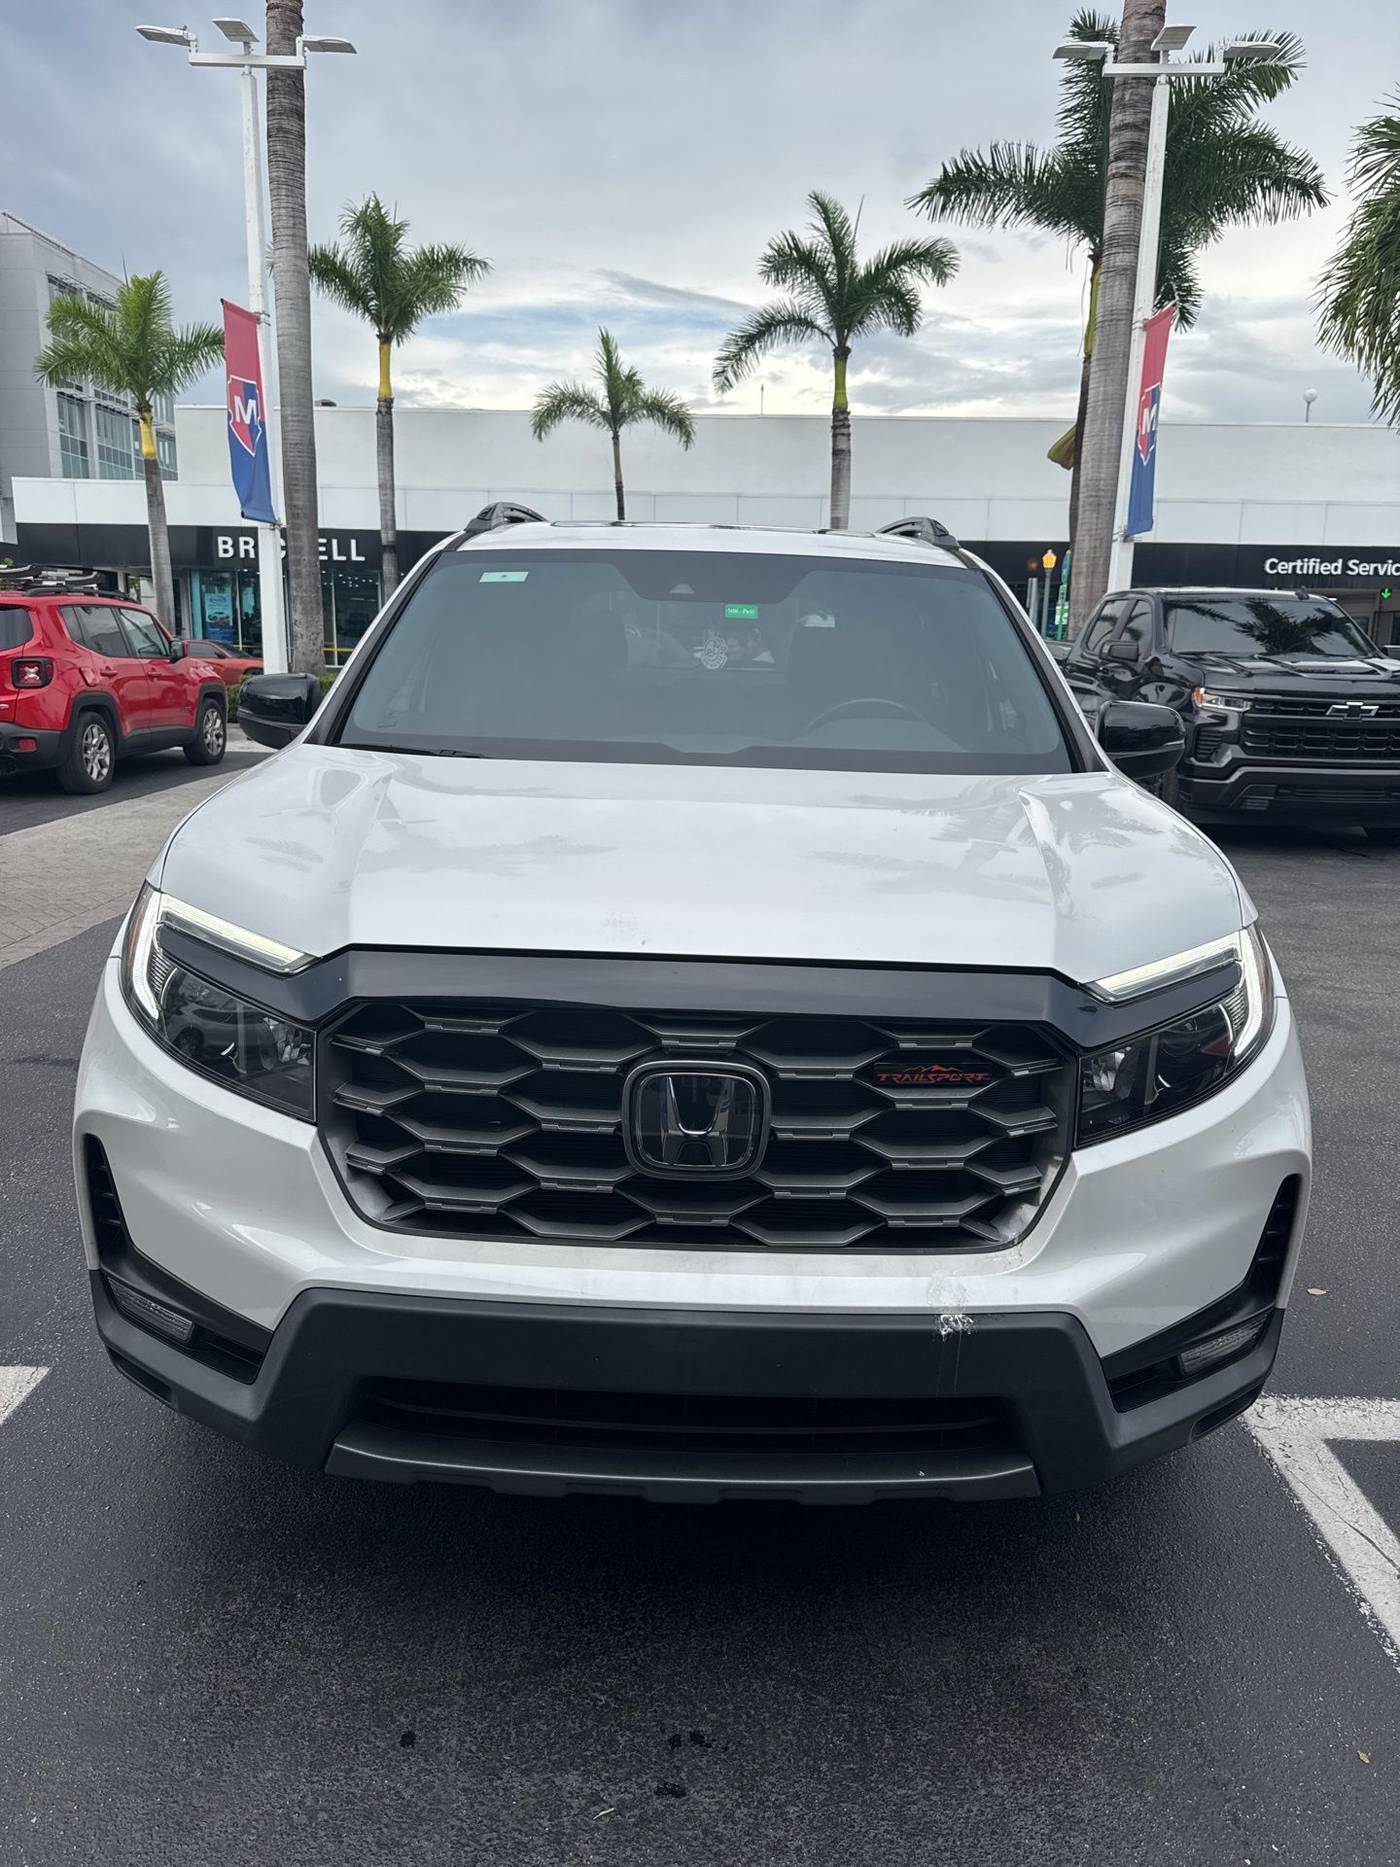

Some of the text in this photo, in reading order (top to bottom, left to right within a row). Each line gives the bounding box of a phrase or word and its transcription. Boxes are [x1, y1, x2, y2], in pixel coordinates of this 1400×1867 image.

[234, 395, 258, 425] M
[1142, 403, 1157, 434] M
[217, 535, 366, 561] BRELL
[1264, 557, 1343, 575] Certified
[877, 1072, 990, 1084] TRAILSPORT
